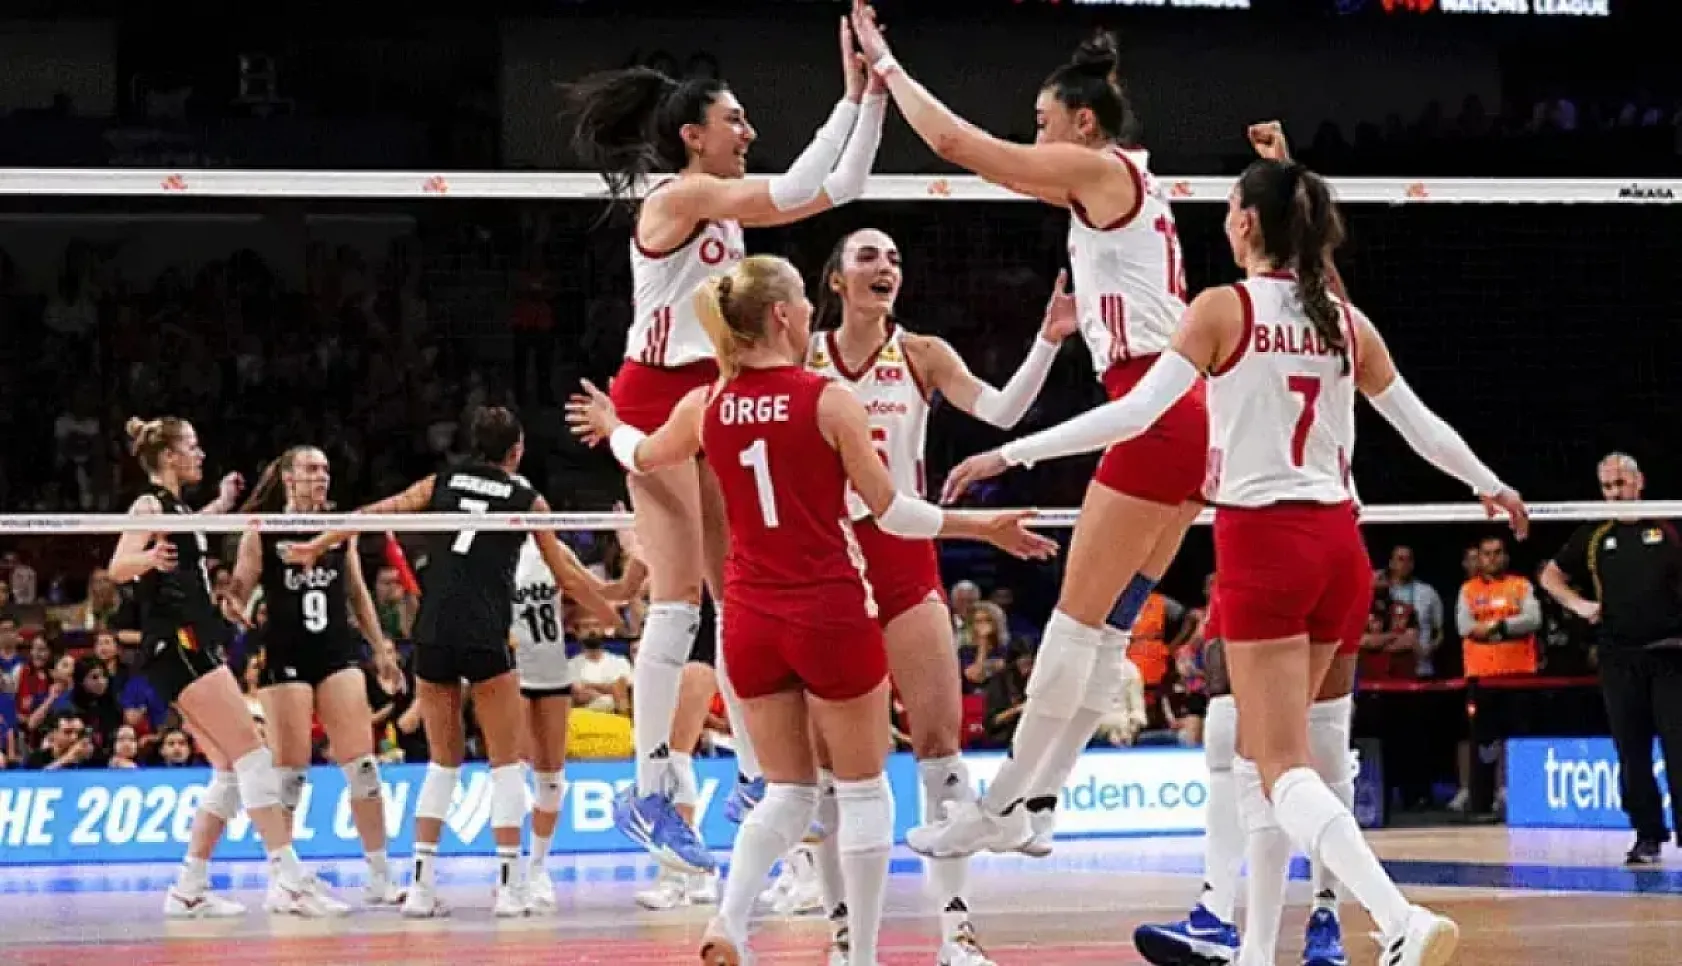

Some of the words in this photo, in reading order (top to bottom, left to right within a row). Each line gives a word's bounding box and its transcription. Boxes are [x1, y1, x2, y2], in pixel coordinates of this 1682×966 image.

[1254, 323, 1342, 356] BALAD
[720, 392, 790, 425] ÖRGE
[1288, 375, 1321, 467] 7
[738, 438, 780, 528] 1
[302, 590, 328, 634] 9
[520, 603, 557, 643] 18
